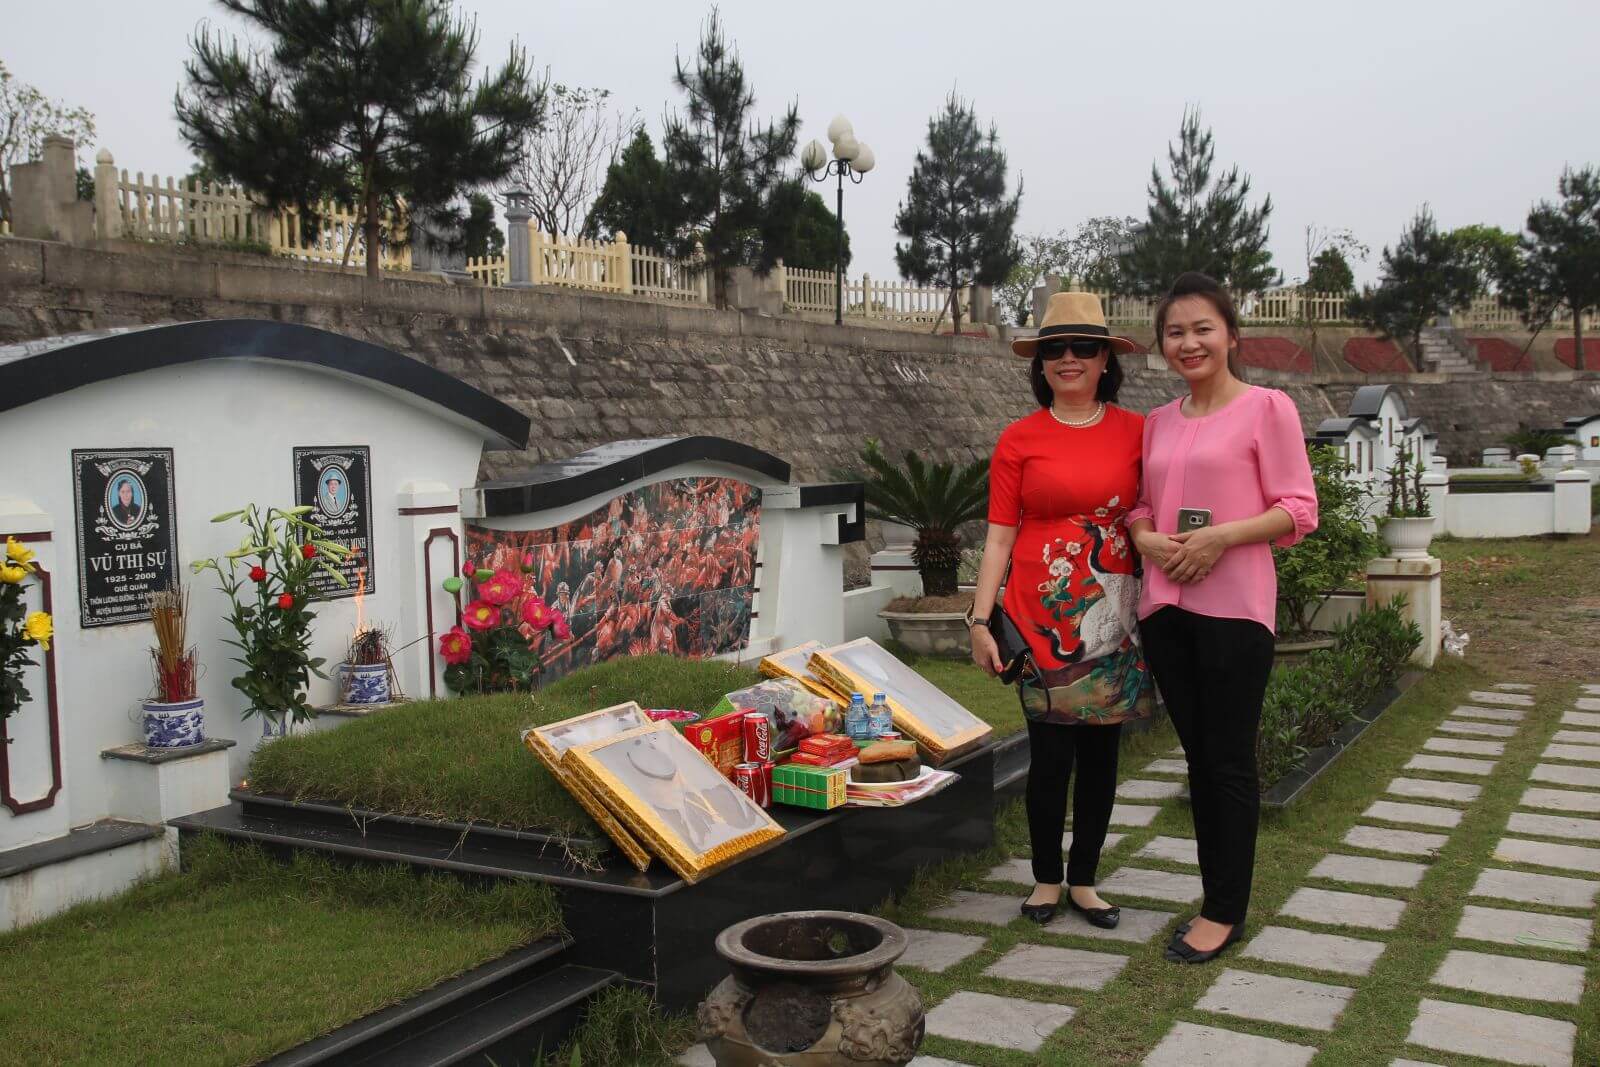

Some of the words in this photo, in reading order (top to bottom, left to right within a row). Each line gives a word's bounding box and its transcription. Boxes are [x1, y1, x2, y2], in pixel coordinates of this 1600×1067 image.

[90, 552, 112, 572] VŨ
[116, 553, 144, 571] THỊ
[147, 549, 167, 570] SỰ
[104, 575, 127, 583] 1925
[135, 572, 157, 580] 2008
